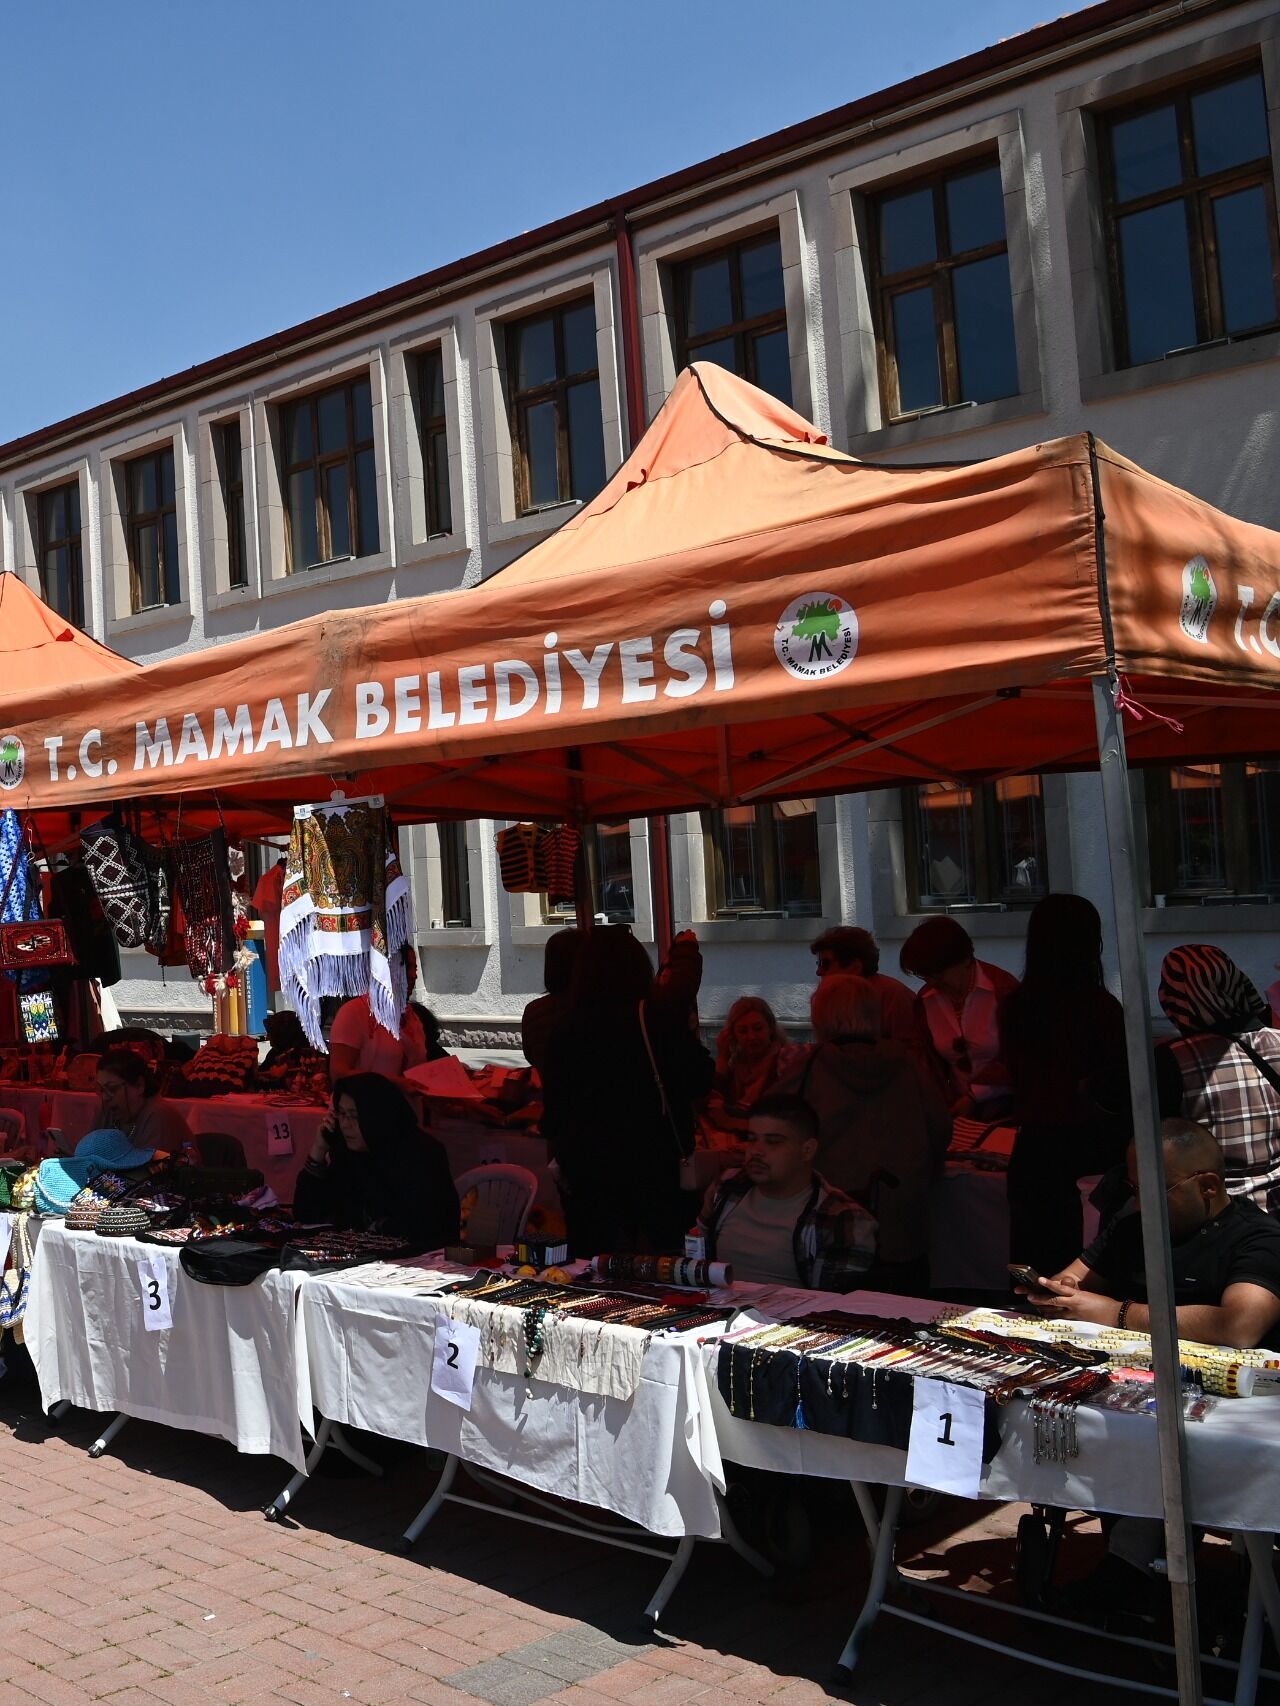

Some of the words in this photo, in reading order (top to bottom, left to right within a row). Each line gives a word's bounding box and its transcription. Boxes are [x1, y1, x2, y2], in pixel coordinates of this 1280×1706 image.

[786, 656, 817, 676] MAMAK
[44, 729, 118, 782] T.C.
[133, 688, 334, 771] MAMAK
[355, 600, 734, 739] BELEDİYESİ
[272, 1122, 290, 1140] 13
[147, 1280, 161, 1311] 3
[446, 1342, 459, 1370] 2
[937, 1412, 955, 1446] 1
